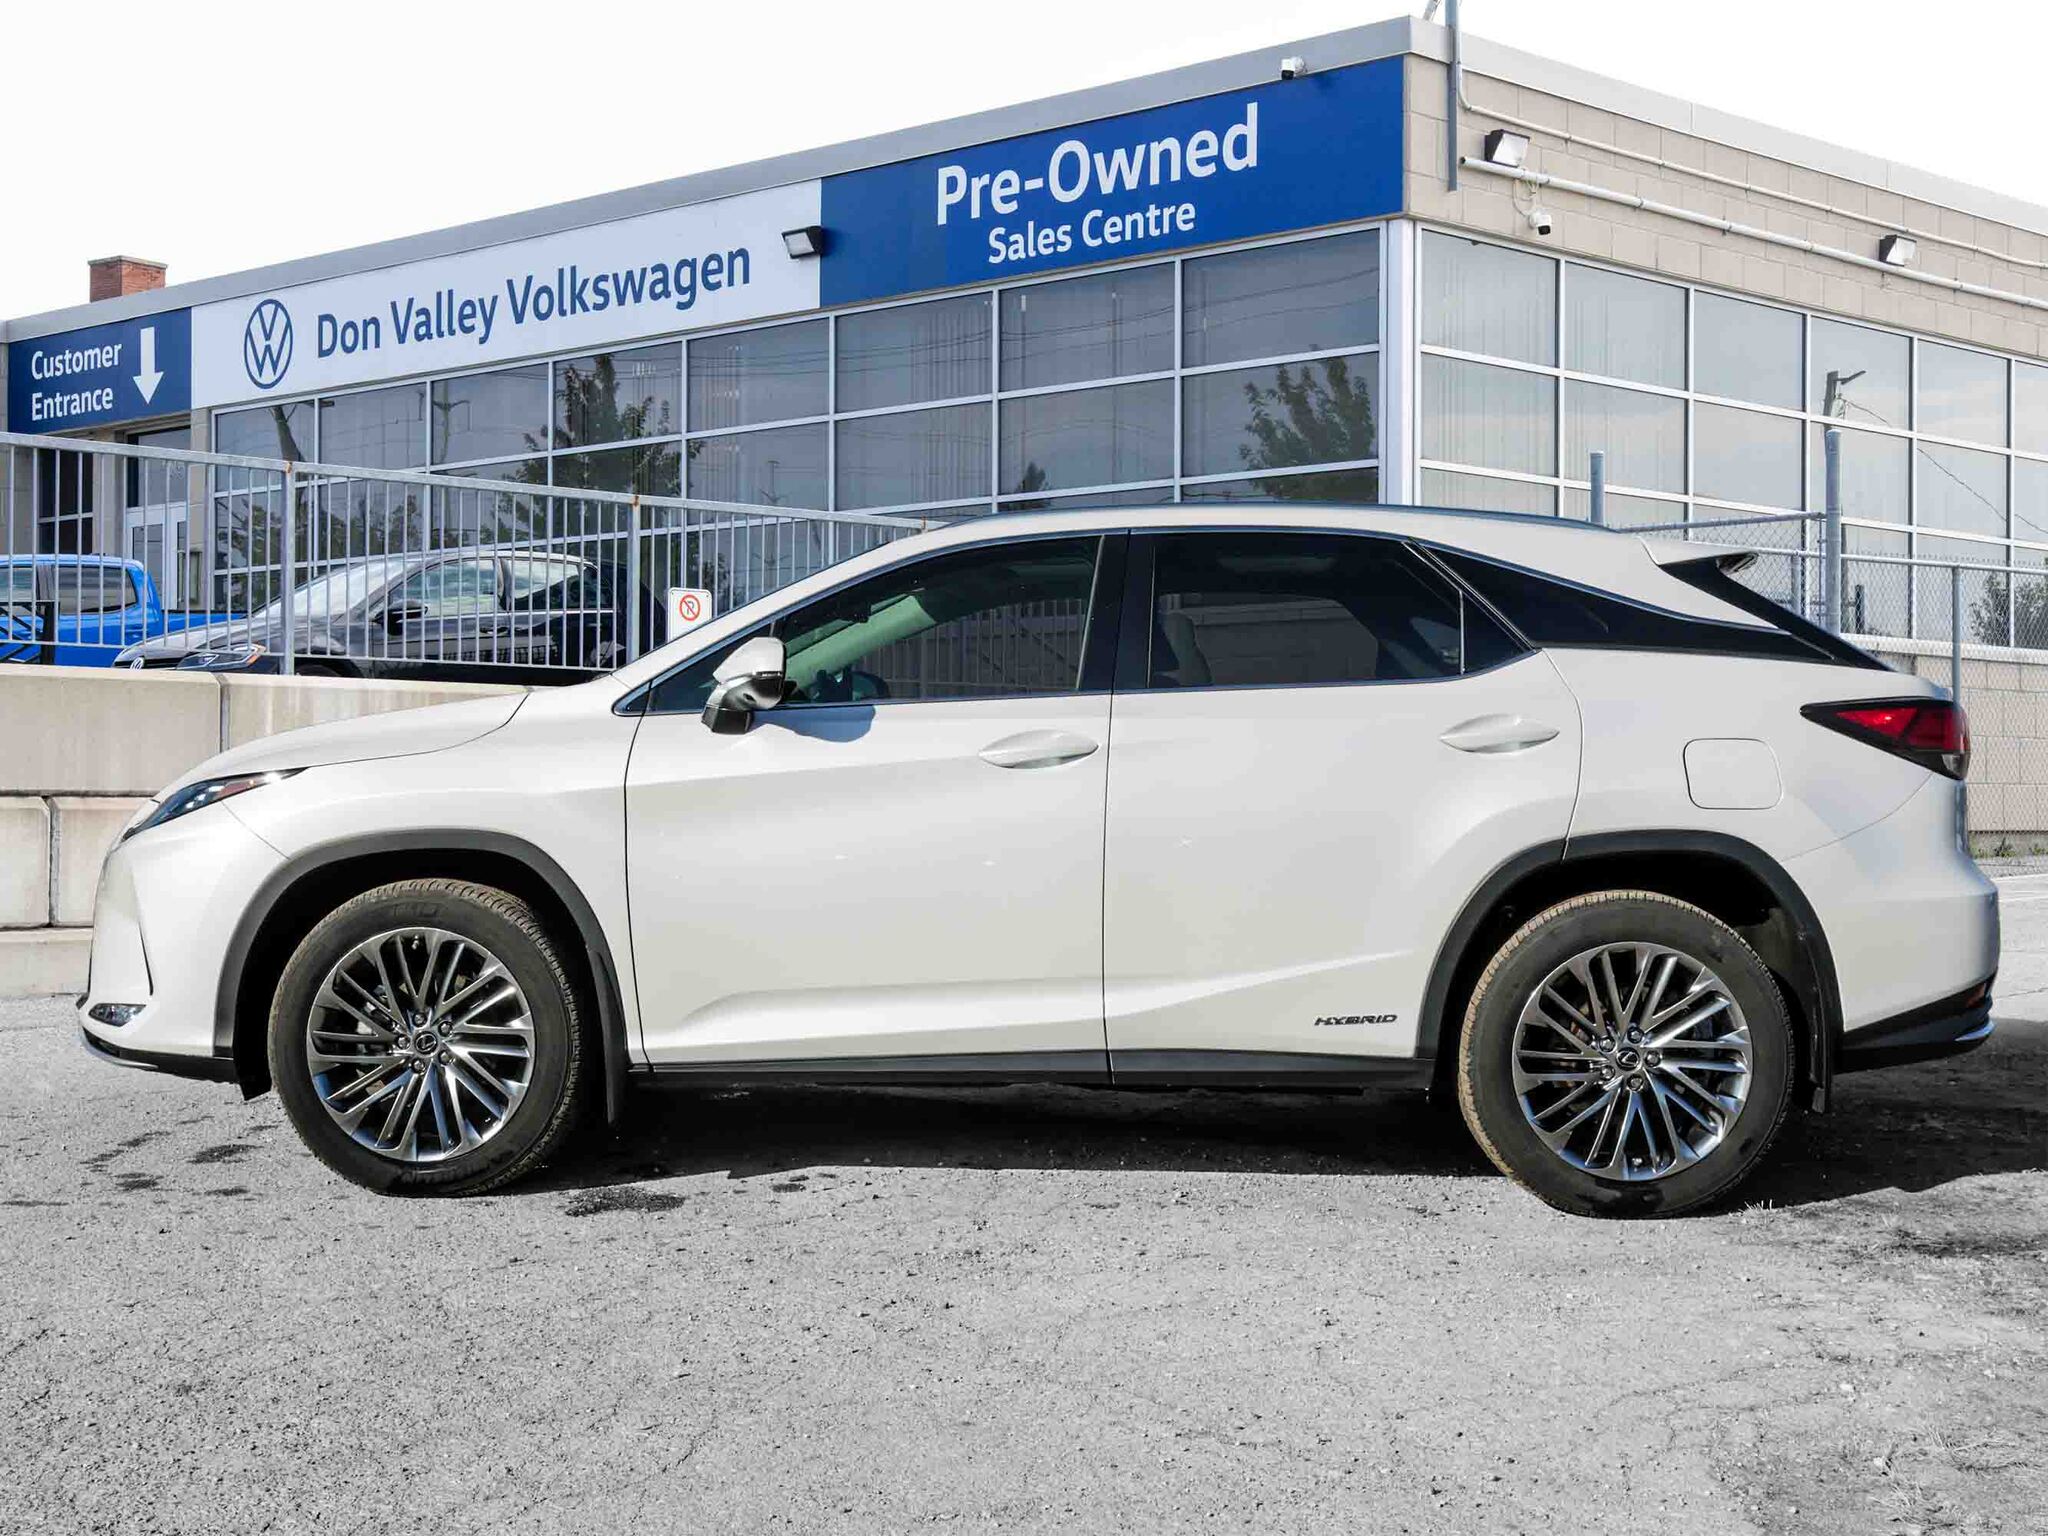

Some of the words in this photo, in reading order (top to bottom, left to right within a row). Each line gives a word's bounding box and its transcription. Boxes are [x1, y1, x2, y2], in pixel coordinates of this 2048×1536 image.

[937, 101, 1259, 227] Pre-Owned
[987, 216, 1073, 265] Sales
[1082, 204, 1197, 247] Centre
[317, 312, 381, 359] Don
[390, 288, 499, 346] Valley
[506, 247, 750, 325] Volkswagen
[30, 340, 123, 381] Customer
[30, 386, 114, 422] Entrance
[1314, 1013, 1398, 1026] HYBRID
